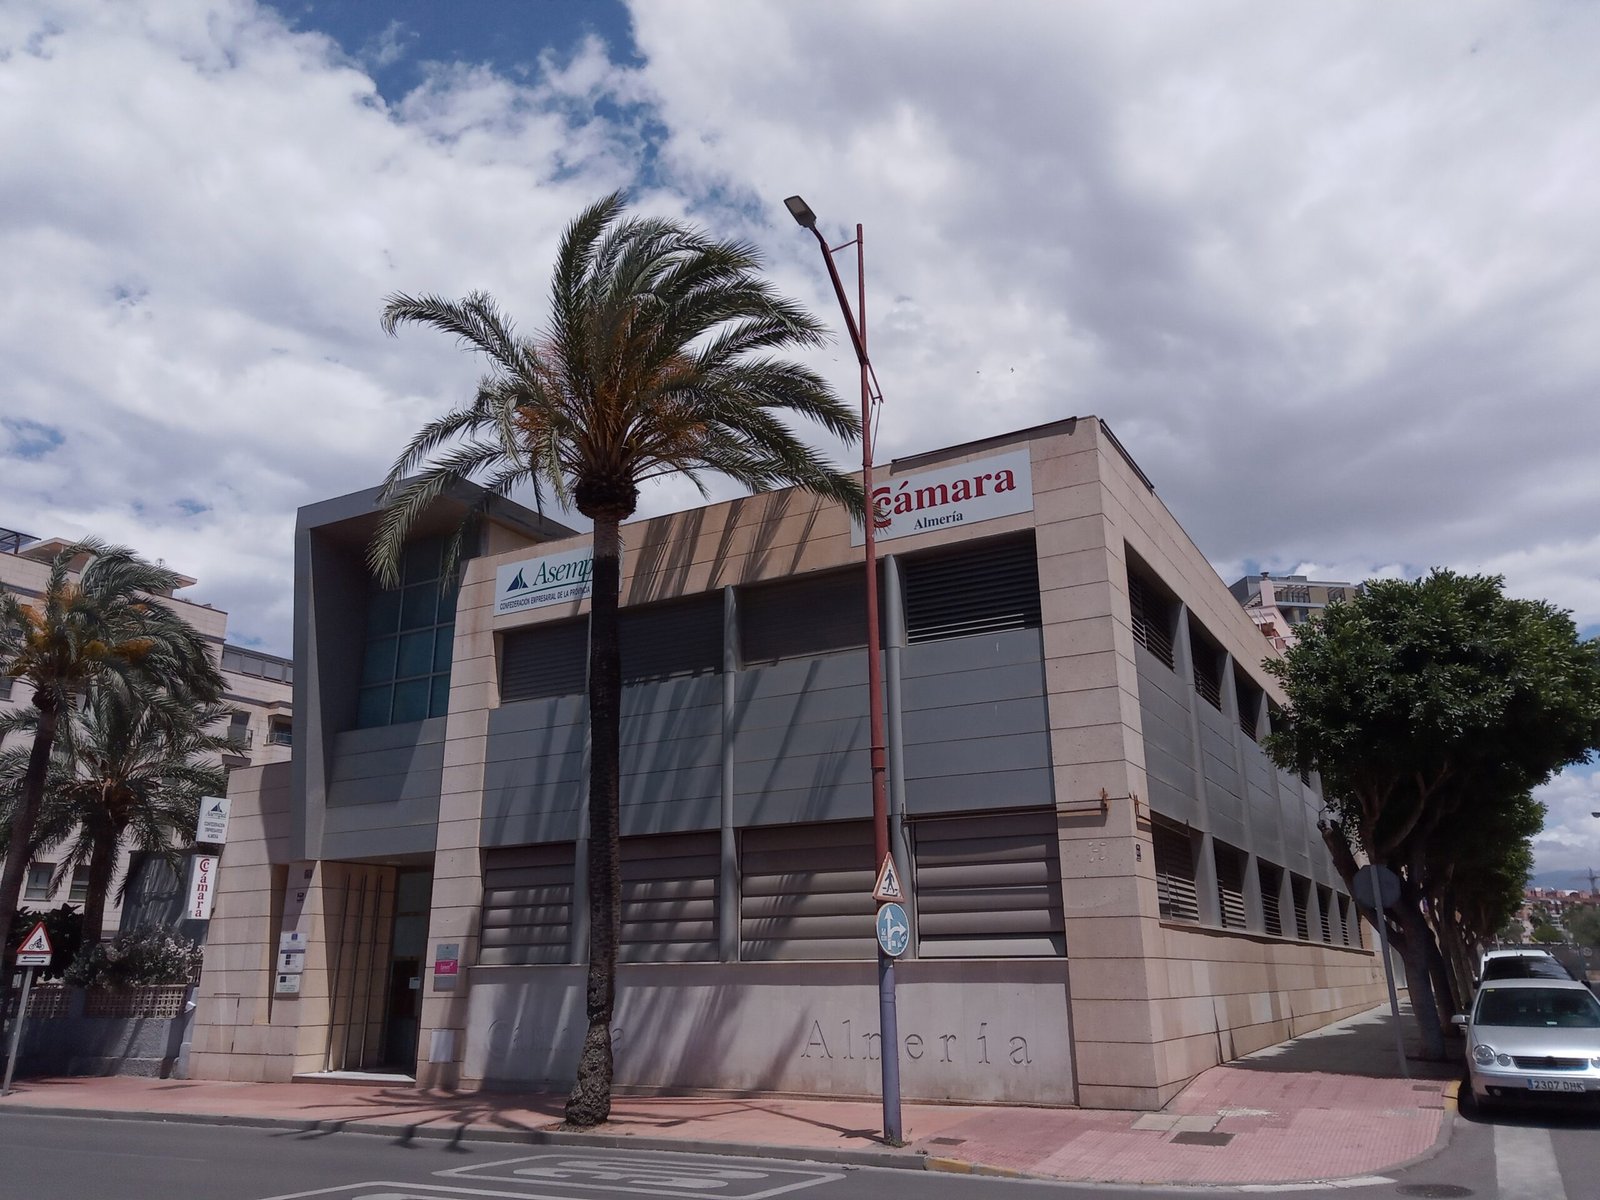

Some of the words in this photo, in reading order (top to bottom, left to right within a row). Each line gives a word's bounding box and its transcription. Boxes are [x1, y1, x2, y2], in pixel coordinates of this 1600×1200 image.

[872, 469, 1017, 529] Cámara
[914, 510, 964, 530] Almería
[533, 559, 593, 586] Asemp
[557, 592, 565, 600] DE
[564, 590, 570, 598] LA
[194, 858, 210, 918] Cámara
[1533, 1080, 1560, 1090] 2307
